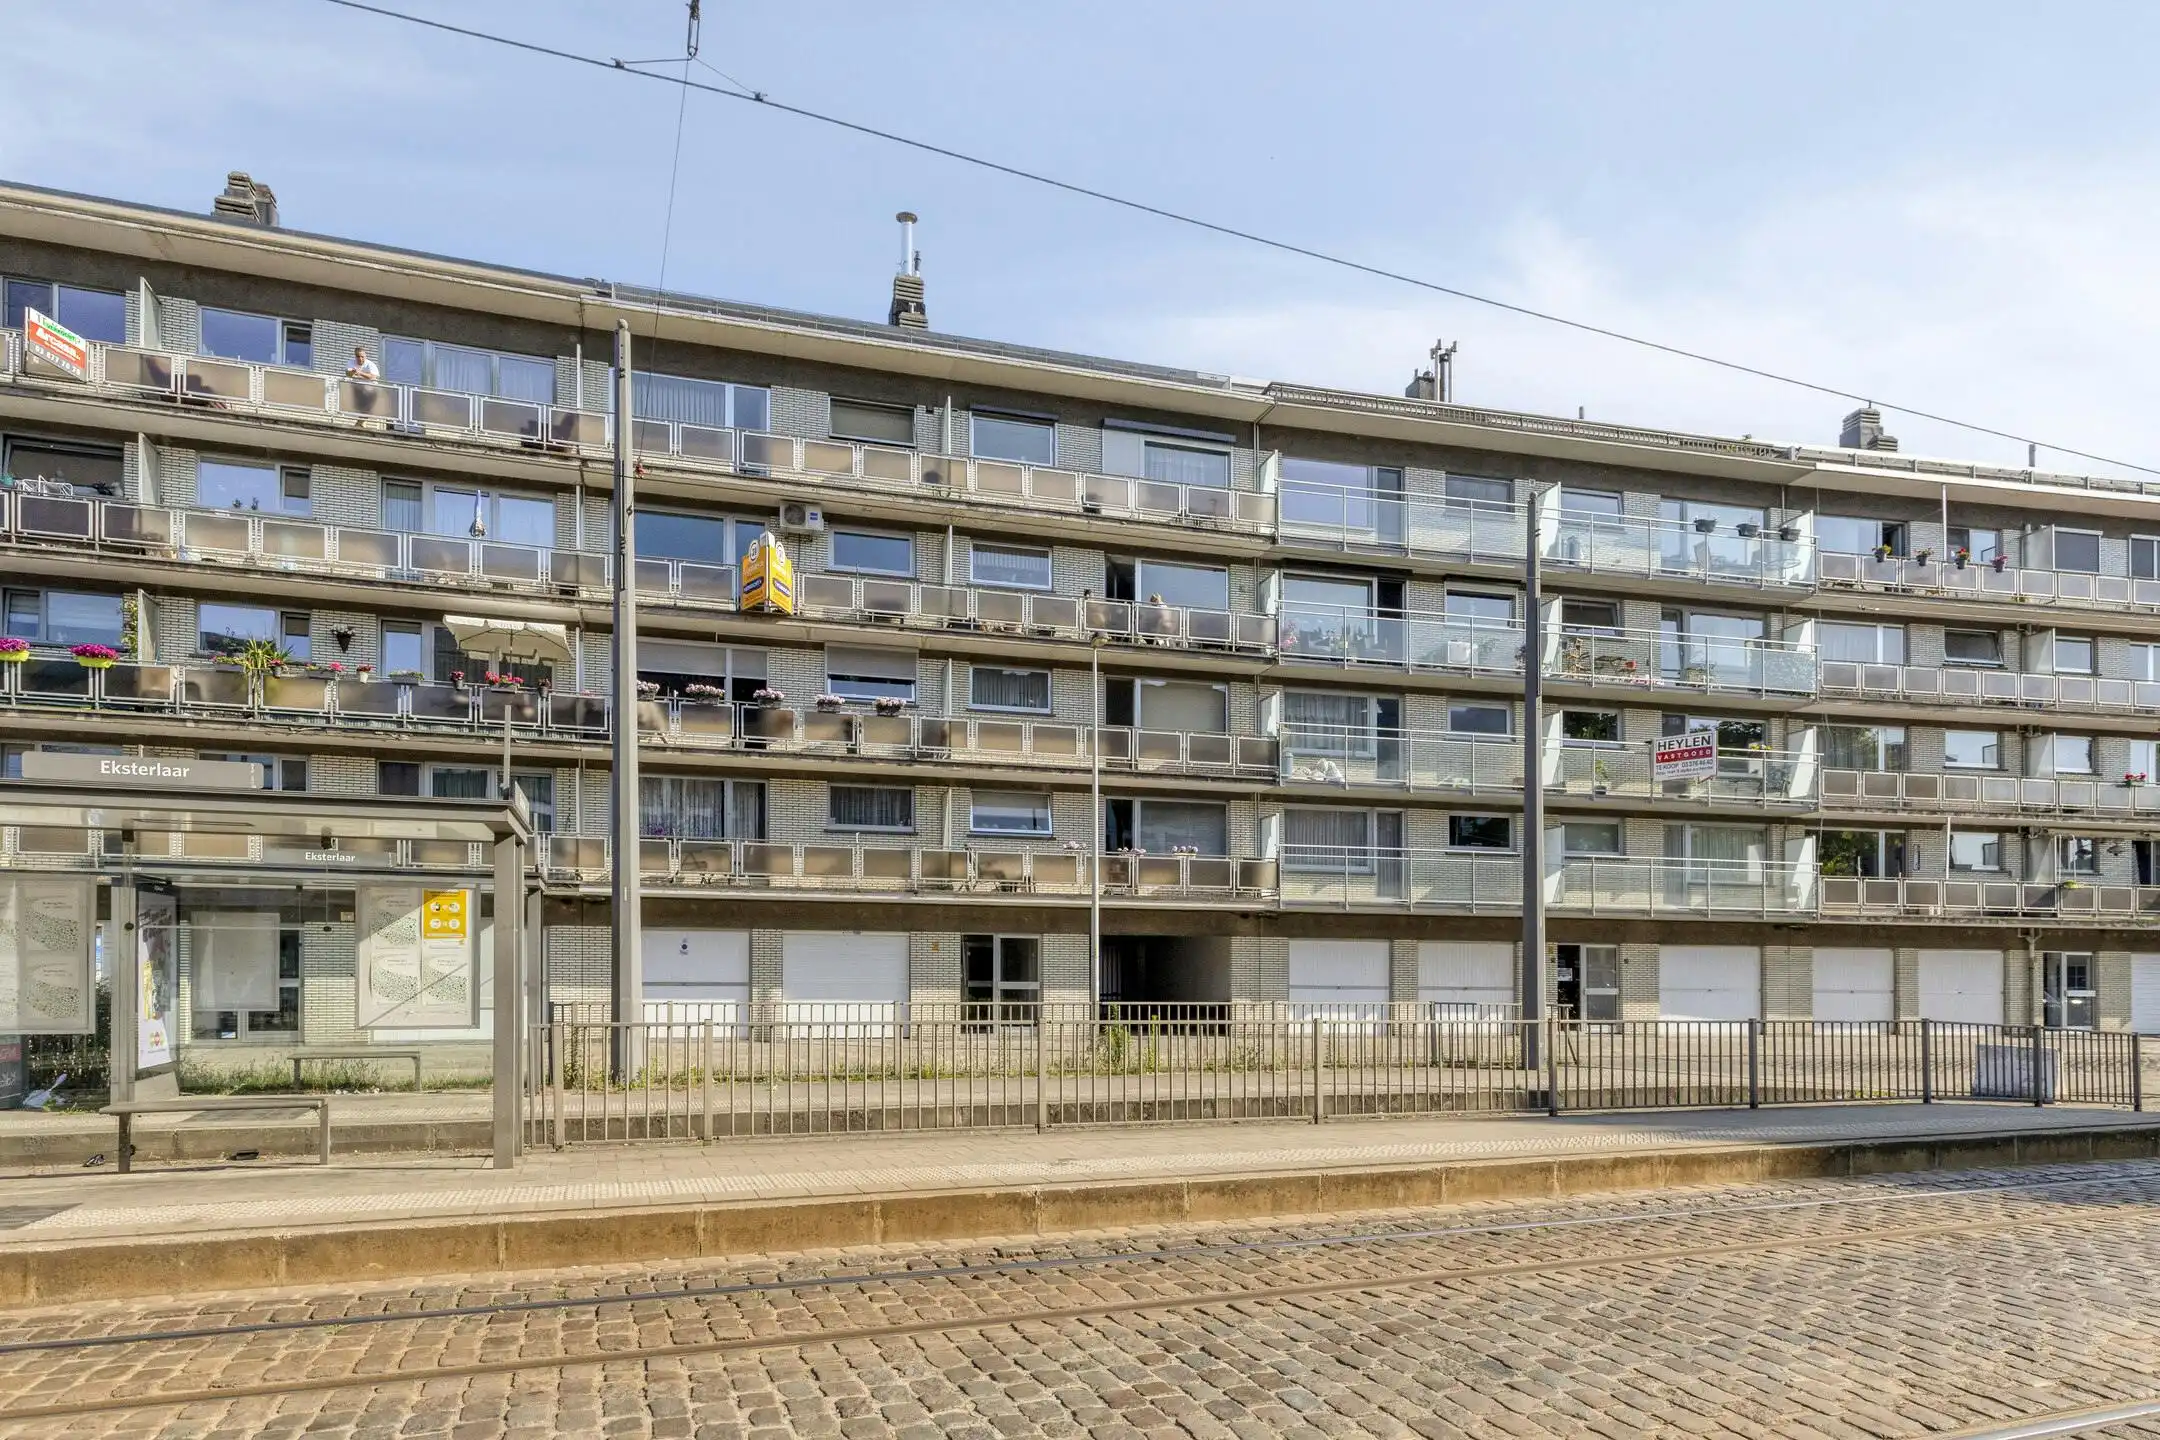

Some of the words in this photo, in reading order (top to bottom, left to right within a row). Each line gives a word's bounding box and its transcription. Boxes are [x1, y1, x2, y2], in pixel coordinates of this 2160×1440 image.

[1657, 735, 1711, 752] HEYLEN
[1657, 749, 1711, 762] VASTGOED
[100, 760, 190, 777] Eksterlaar
[305, 851, 356, 862] Eksterlaar
